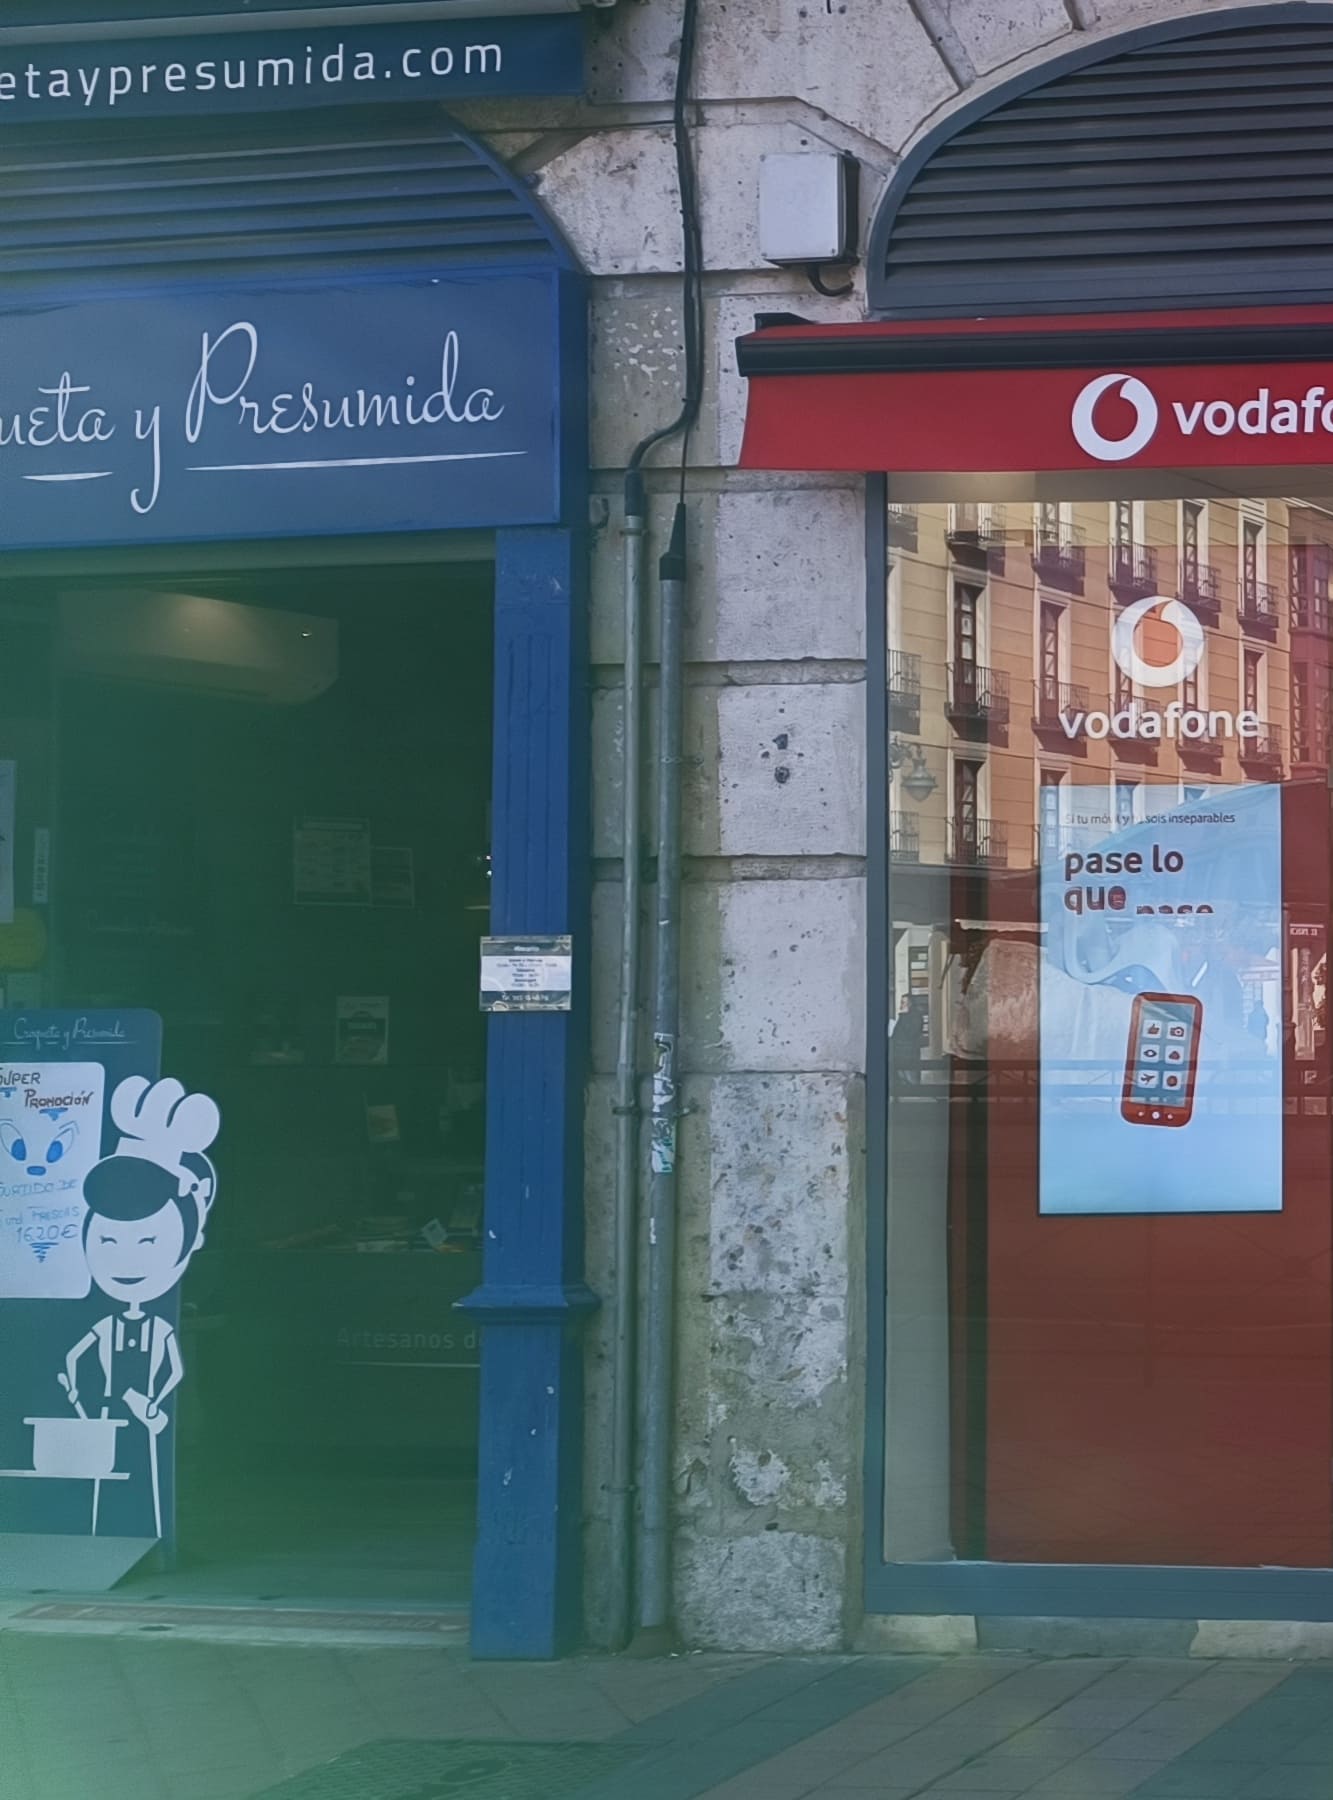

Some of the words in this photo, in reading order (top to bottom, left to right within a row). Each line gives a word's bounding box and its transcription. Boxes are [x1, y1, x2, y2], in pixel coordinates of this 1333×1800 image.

[130, 403, 162, 515] y
[185, 321, 505, 444] Presumida
[1058, 700, 1260, 739] vodafone
[1077, 813, 1089, 825] tu
[1168, 811, 1236, 826] inseparables
[1064, 851, 1143, 882] pase
[1152, 844, 1184, 873] lo
[1063, 885, 1127, 916] que
